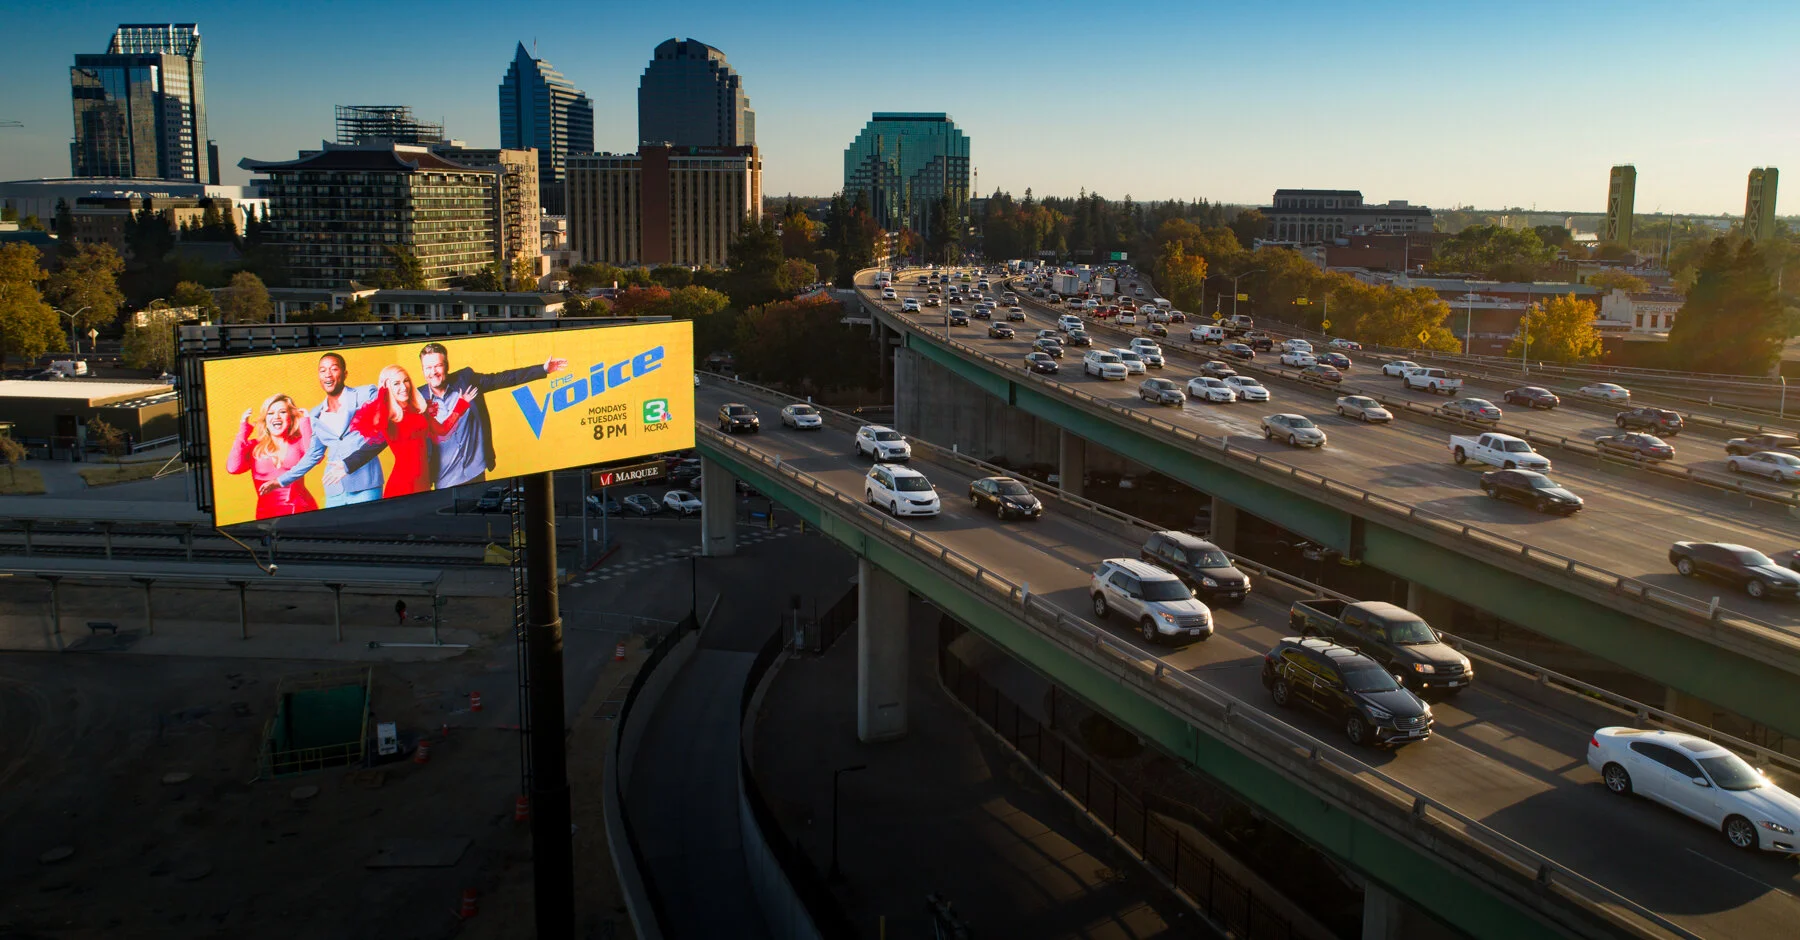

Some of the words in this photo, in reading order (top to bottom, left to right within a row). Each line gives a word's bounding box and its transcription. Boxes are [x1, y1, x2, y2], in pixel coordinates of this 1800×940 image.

[550, 373, 573, 388] the
[511, 345, 664, 440] Voice
[588, 403, 627, 415] MONDAYS
[645, 400, 666, 421] 3
[580, 418, 586, 426] &
[587, 412, 627, 425] TUESDAYS
[593, 424, 604, 441] 8
[606, 423, 627, 439] PM
[644, 422, 669, 433] KCRA
[615, 467, 659, 482] MARQUEE
